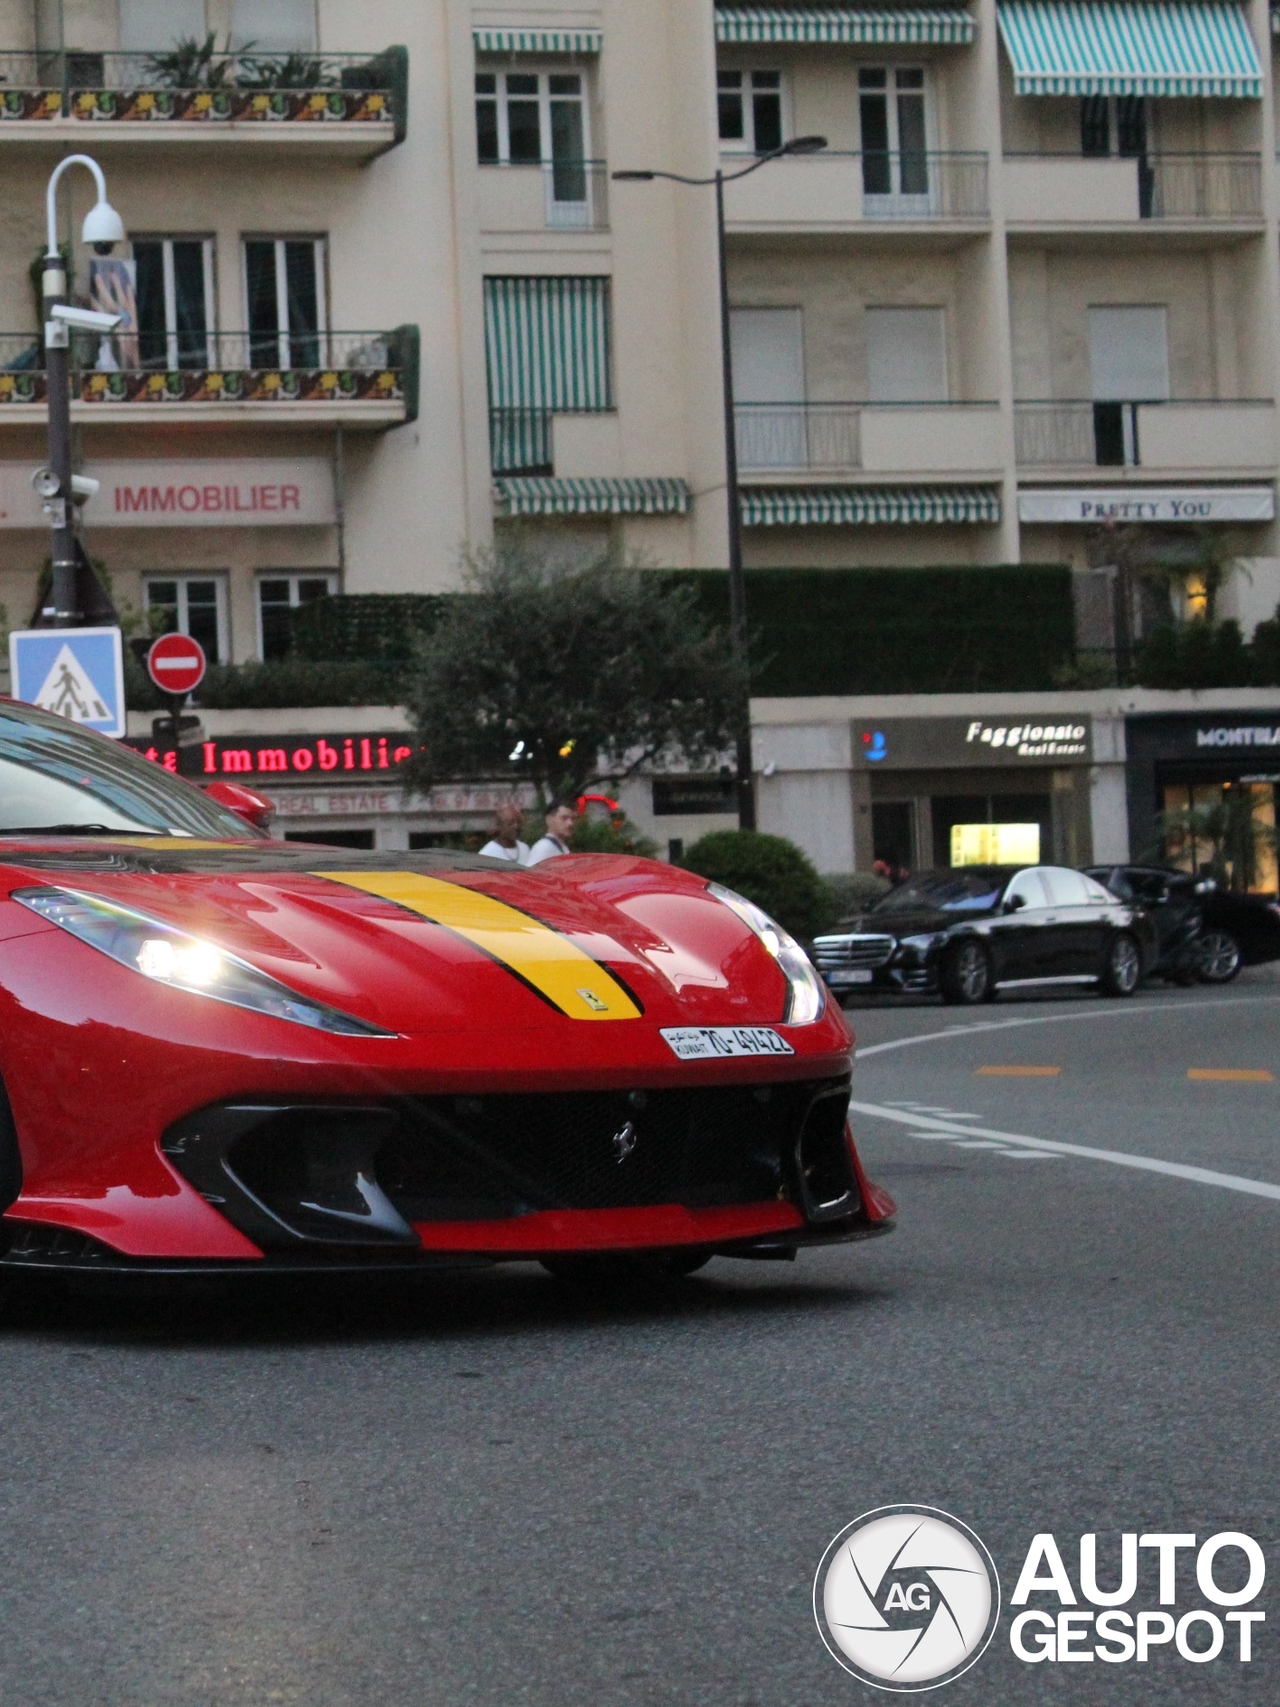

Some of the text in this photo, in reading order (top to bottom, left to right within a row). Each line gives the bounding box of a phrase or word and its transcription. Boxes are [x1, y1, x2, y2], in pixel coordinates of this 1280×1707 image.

[114, 484, 301, 512] IMMOBILIER
[1171, 500, 1212, 516] YOU
[966, 721, 1086, 747] Faggionato
[203, 737, 425, 773] Immobilie
[1018, 742, 1047, 756] Real
[328, 793, 389, 812] ESTATE
[674, 1042, 710, 1056] KUWAIT
[699, 1029, 791, 1054] 70-49422
